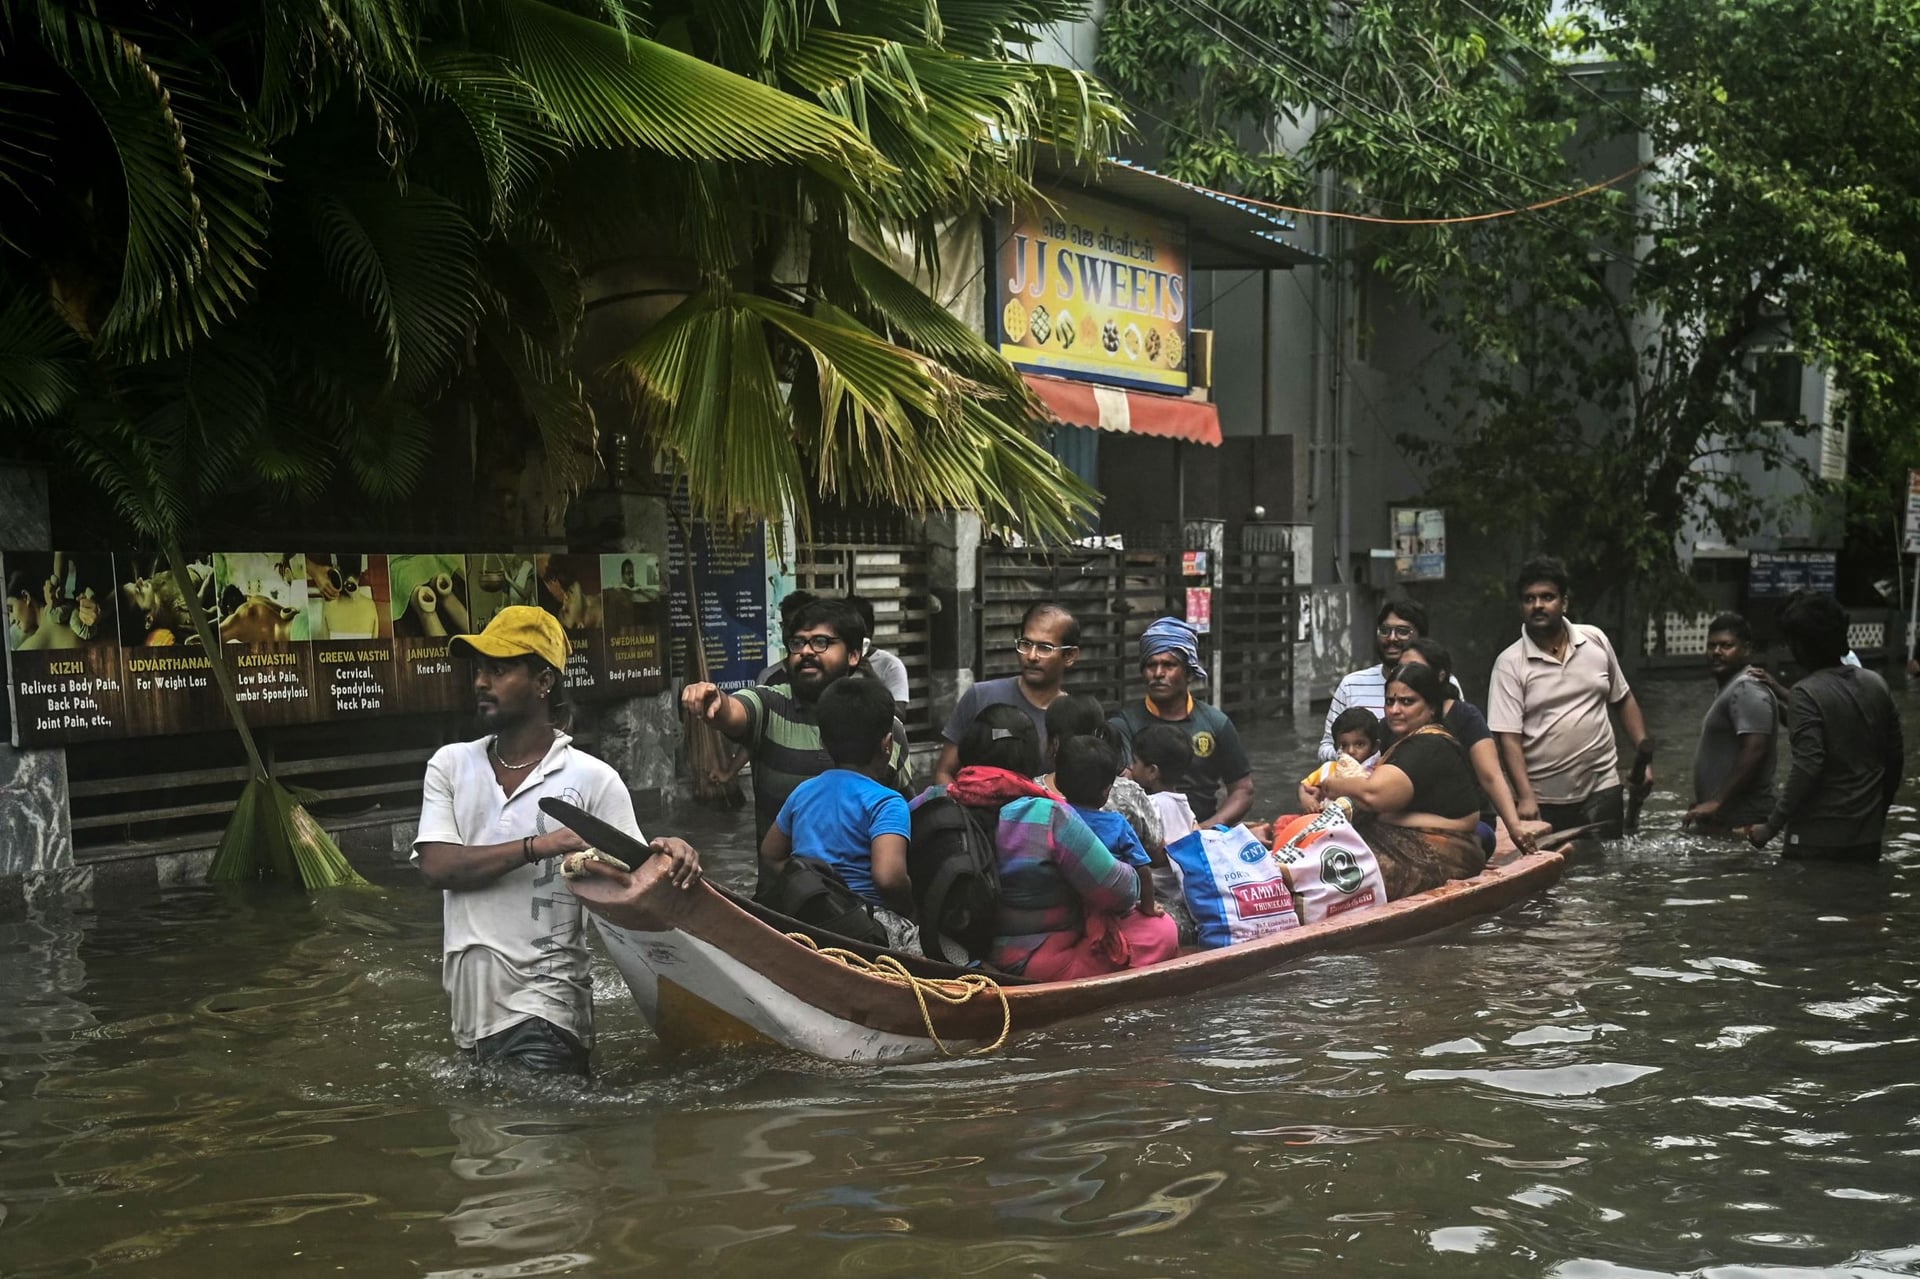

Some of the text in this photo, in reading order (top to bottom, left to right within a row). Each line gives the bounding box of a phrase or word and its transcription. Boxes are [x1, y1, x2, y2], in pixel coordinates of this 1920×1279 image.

[1057, 249, 1184, 323] SWEETS
[611, 634, 656, 647] SWEDHANAM
[238, 653, 297, 667] KATIVASTHI
[319, 650, 389, 663] GREEVA VASTHI
[407, 646, 449, 662] JANUVAST
[50, 661, 84, 675] KIZHI
[336, 666, 374, 680] Cervical,
[417, 662, 452, 675] Knee Pain
[565, 665, 588, 677] igrain,
[609, 669, 626, 682] Body
[627, 668, 642, 679] Pain
[137, 674, 207, 690] For Weight Loss
[238, 670, 299, 685] Low Back Pain,
[575, 674, 595, 687] Block
[717, 679, 756, 690] GOODBYE TO
[21, 677, 120, 695] Relives a Body Pain,
[331, 681, 384, 698] Spondylosis,
[236, 686, 308, 703] umbar Spondylosis
[48, 696, 98, 711] Back Pain,
[337, 697, 380, 711] Neck Pain
[37, 717, 61, 730] Joint
[64, 715, 88, 728] Pain,
[1242, 844, 1265, 861] TNT
